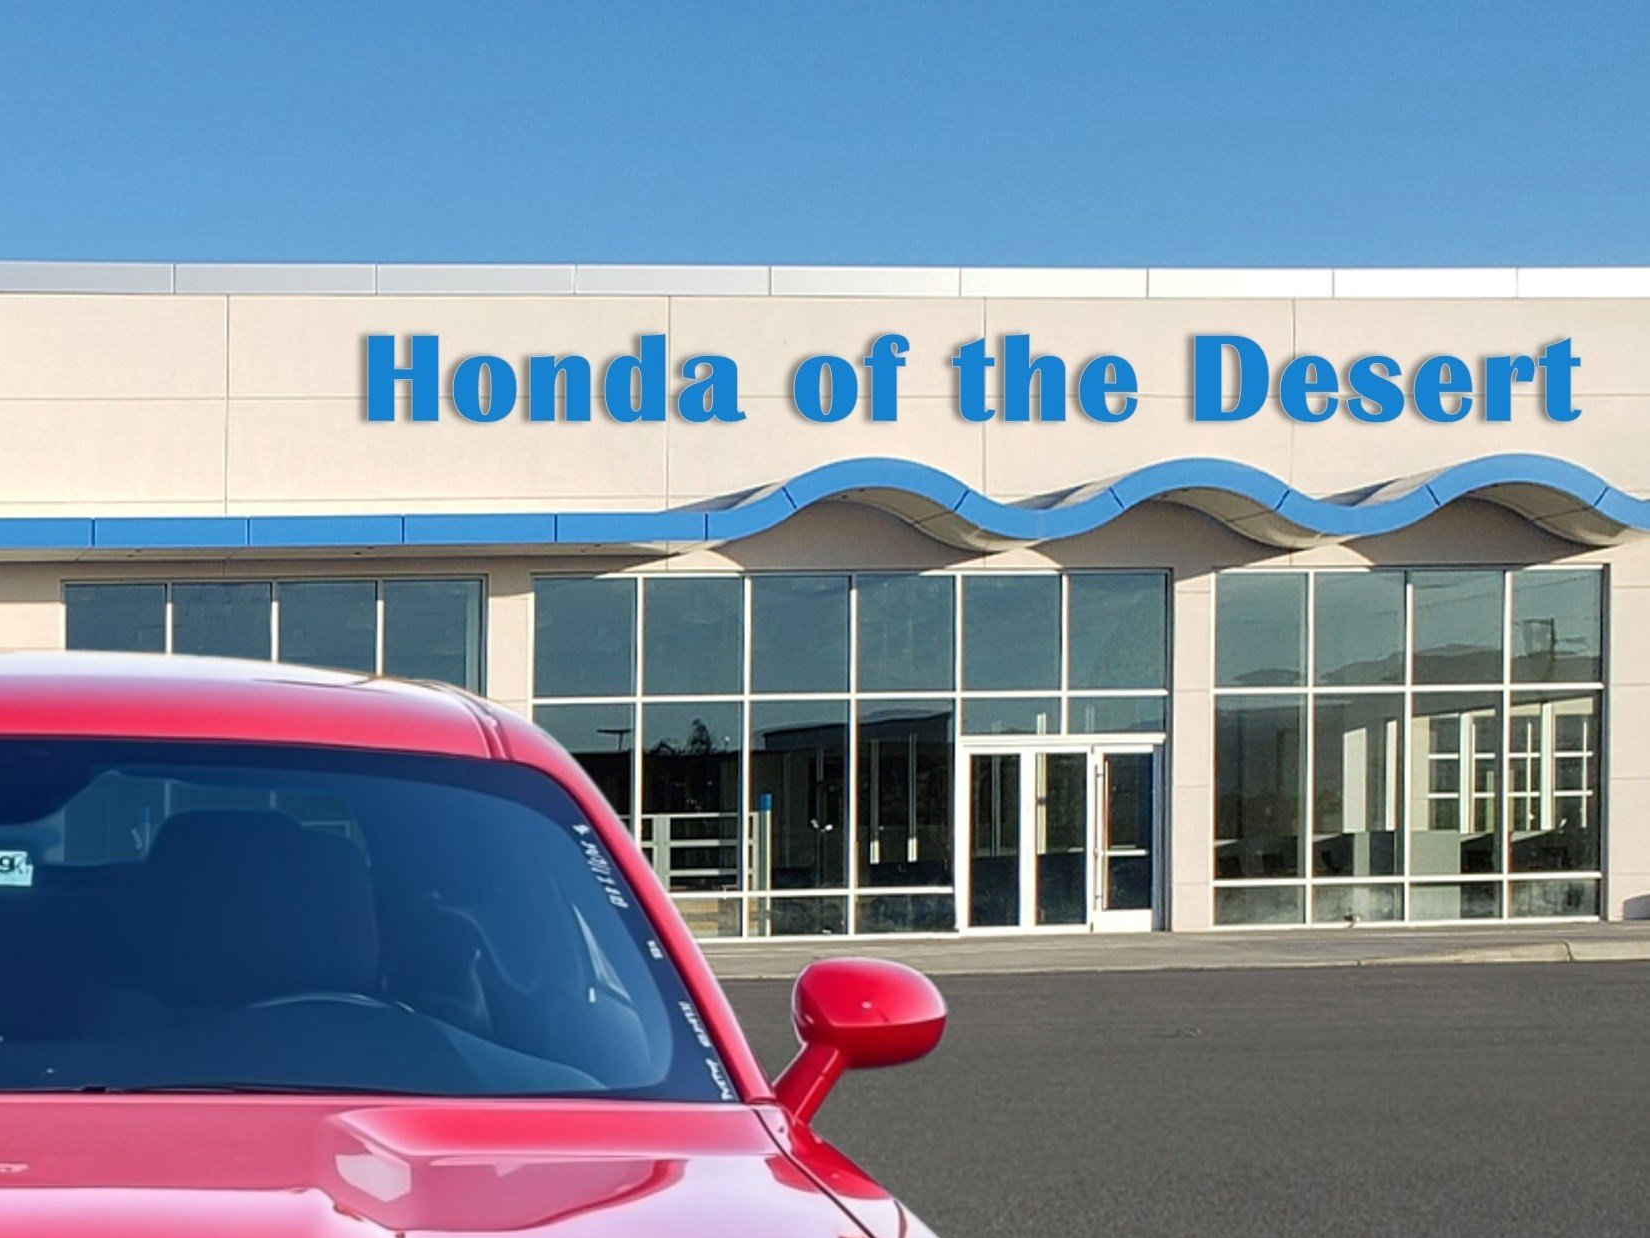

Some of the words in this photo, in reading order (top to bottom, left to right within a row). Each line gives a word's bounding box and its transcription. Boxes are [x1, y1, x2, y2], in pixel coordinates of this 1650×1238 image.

[366, 333, 747, 423] Honda
[793, 333, 910, 423] of
[952, 333, 1139, 423] the
[1192, 334, 1583, 423] Desert
